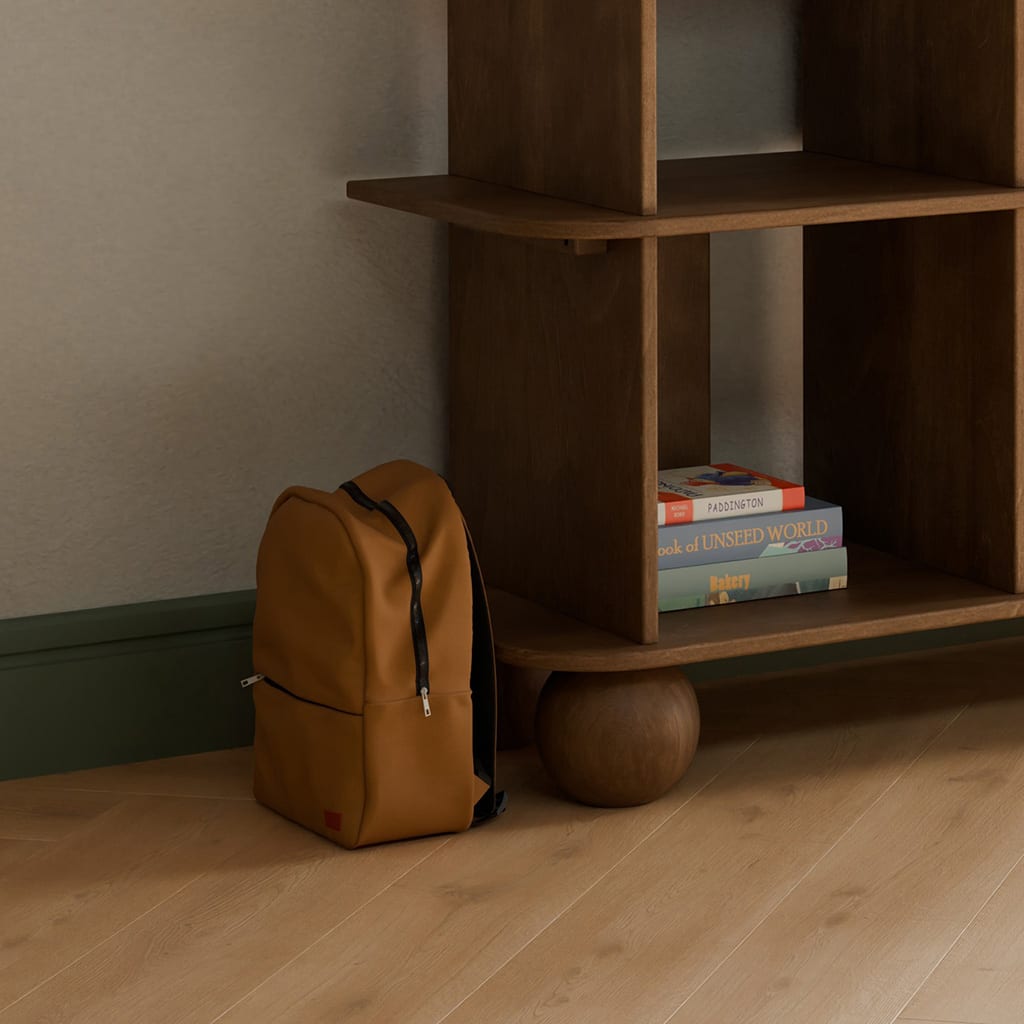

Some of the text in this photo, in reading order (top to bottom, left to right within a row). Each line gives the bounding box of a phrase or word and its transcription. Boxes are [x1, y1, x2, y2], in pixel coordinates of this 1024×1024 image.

[707, 497, 764, 513] PADDINGTON
[657, 519, 829, 556] ook of UNSEED WORLD
[709, 573, 751, 593] Bakery
